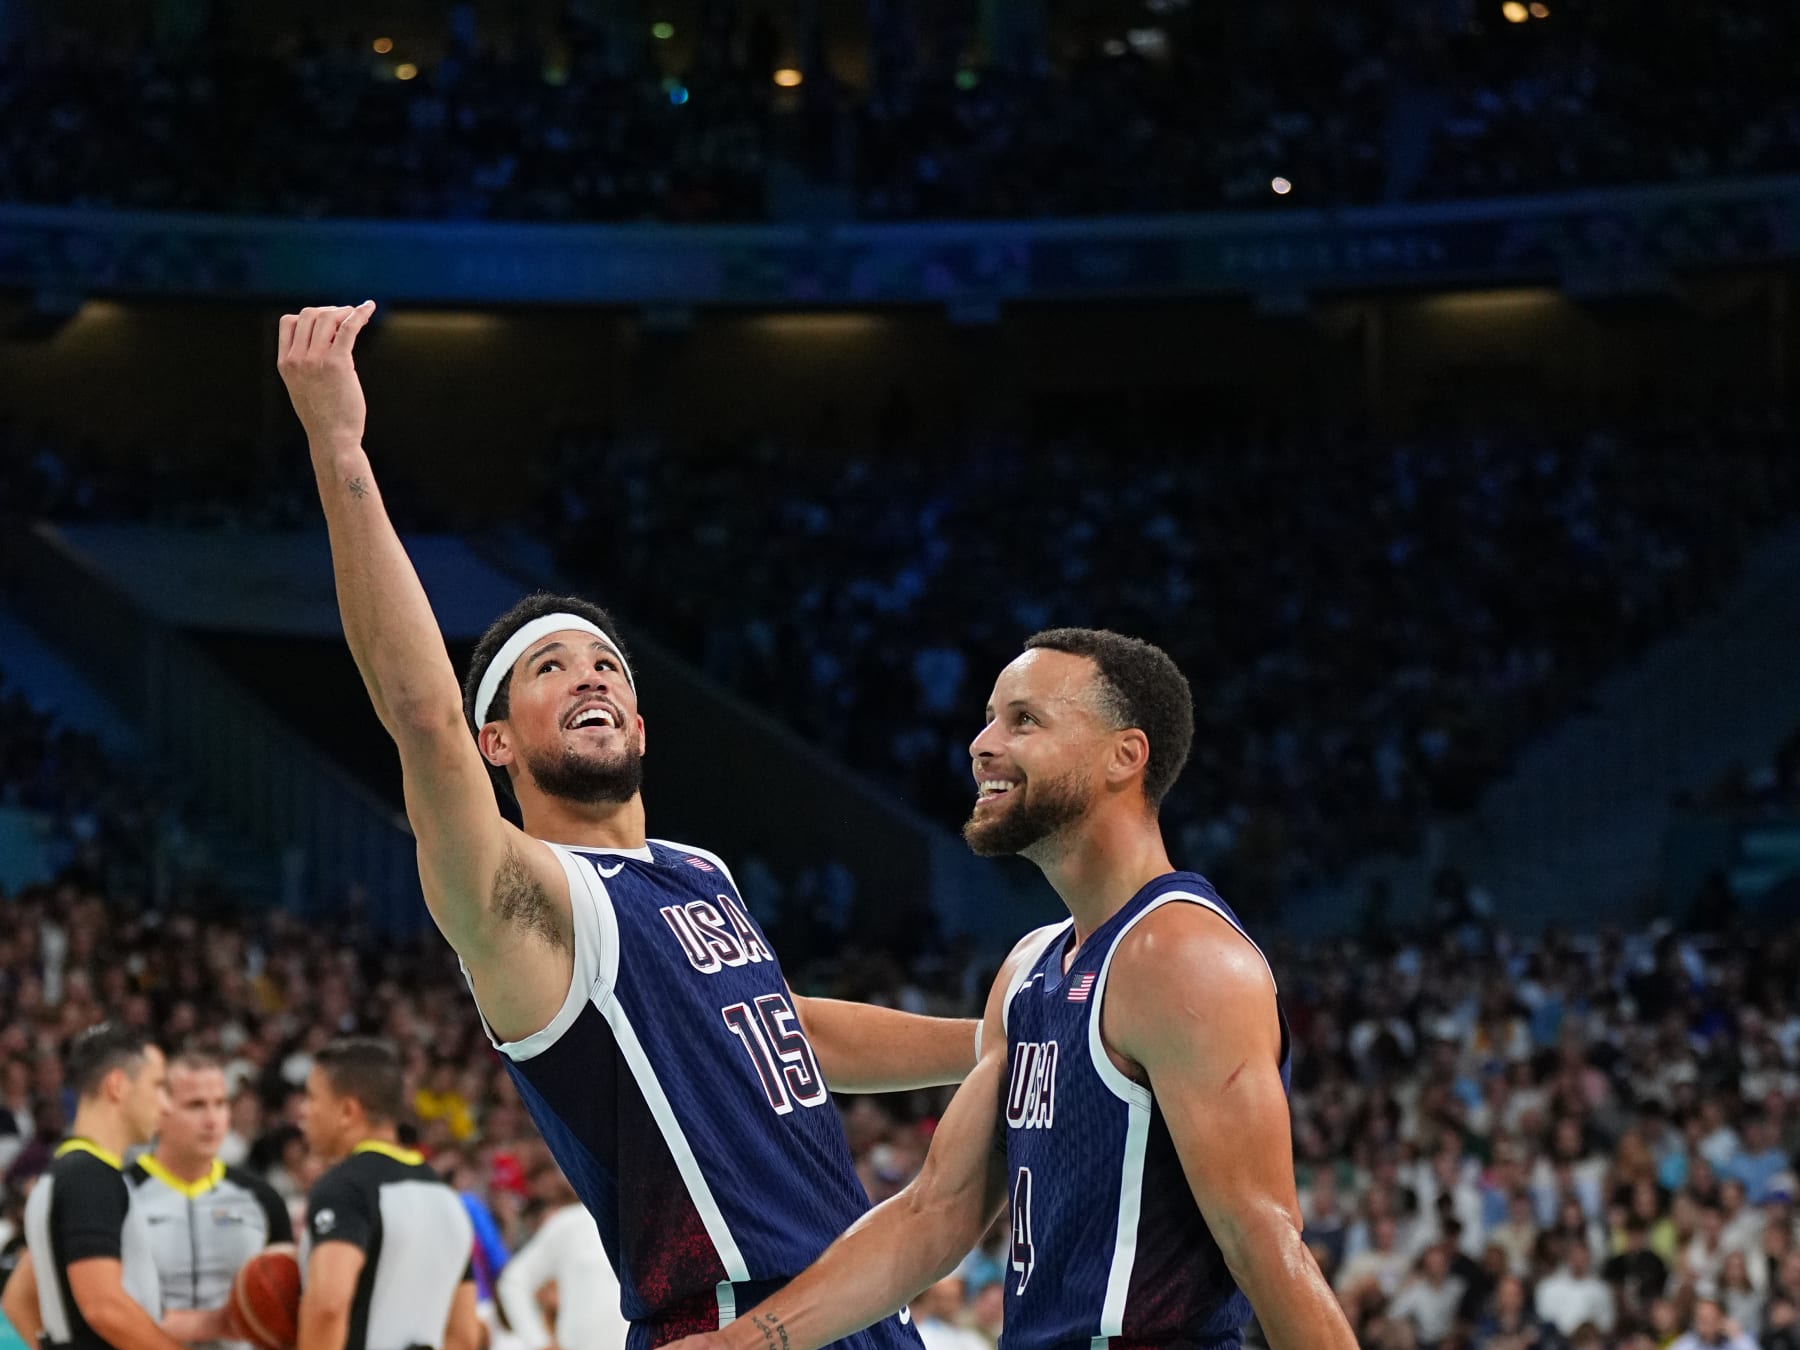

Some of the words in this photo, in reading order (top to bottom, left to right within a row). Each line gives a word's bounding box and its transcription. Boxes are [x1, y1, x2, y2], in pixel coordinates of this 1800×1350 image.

[660, 894, 773, 974] USA
[721, 993, 827, 1115] 15
[1012, 1167, 1034, 1296] 4
